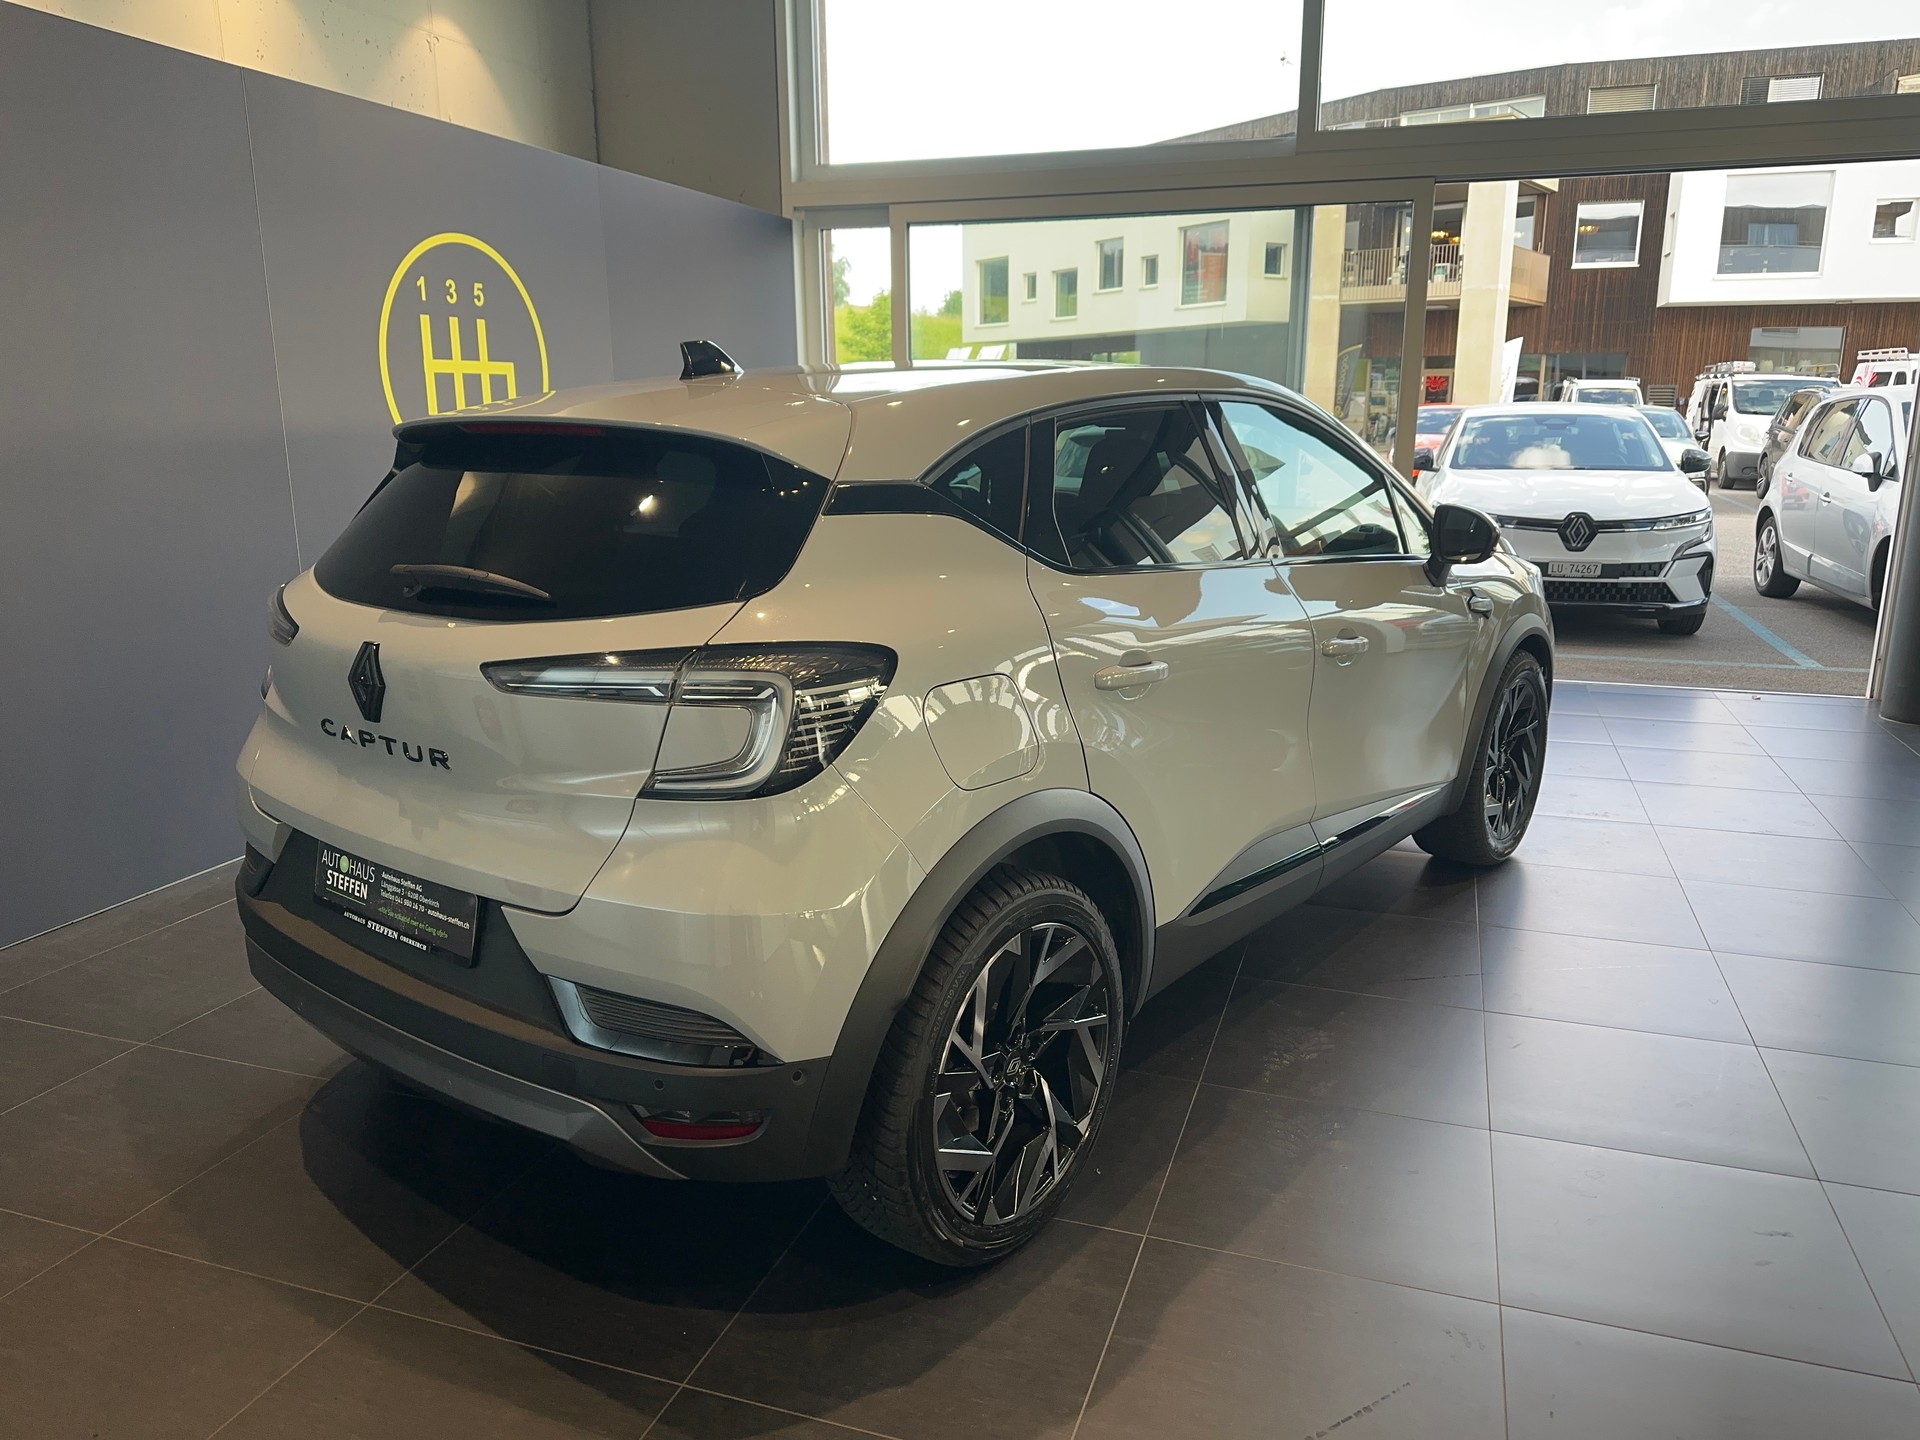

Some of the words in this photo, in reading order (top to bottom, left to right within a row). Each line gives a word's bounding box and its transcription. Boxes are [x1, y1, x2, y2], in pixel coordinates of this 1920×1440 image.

[416, 275, 427, 301] 1
[445, 278, 458, 304] 3
[473, 282, 485, 307] 5
[1551, 563, 1564, 574] LU
[1569, 564, 1599, 574] 74267
[320, 718, 452, 770] CAPTUR
[321, 849, 376, 883] AUTOHAUS
[381, 871, 401, 884] Autohaus
[400, 878, 416, 890] Steffen
[415, 884, 423, 892] AG
[326, 869, 368, 900] STEFFEN
[418, 894, 440, 909] Oberkirch
[343, 911, 366, 925] AUTOHAUS
[366, 919, 399, 940] STEFFEN
[399, 935, 427, 951] OBERKIRCH
[427, 909, 470, 930] autohaus-steffen.ch
